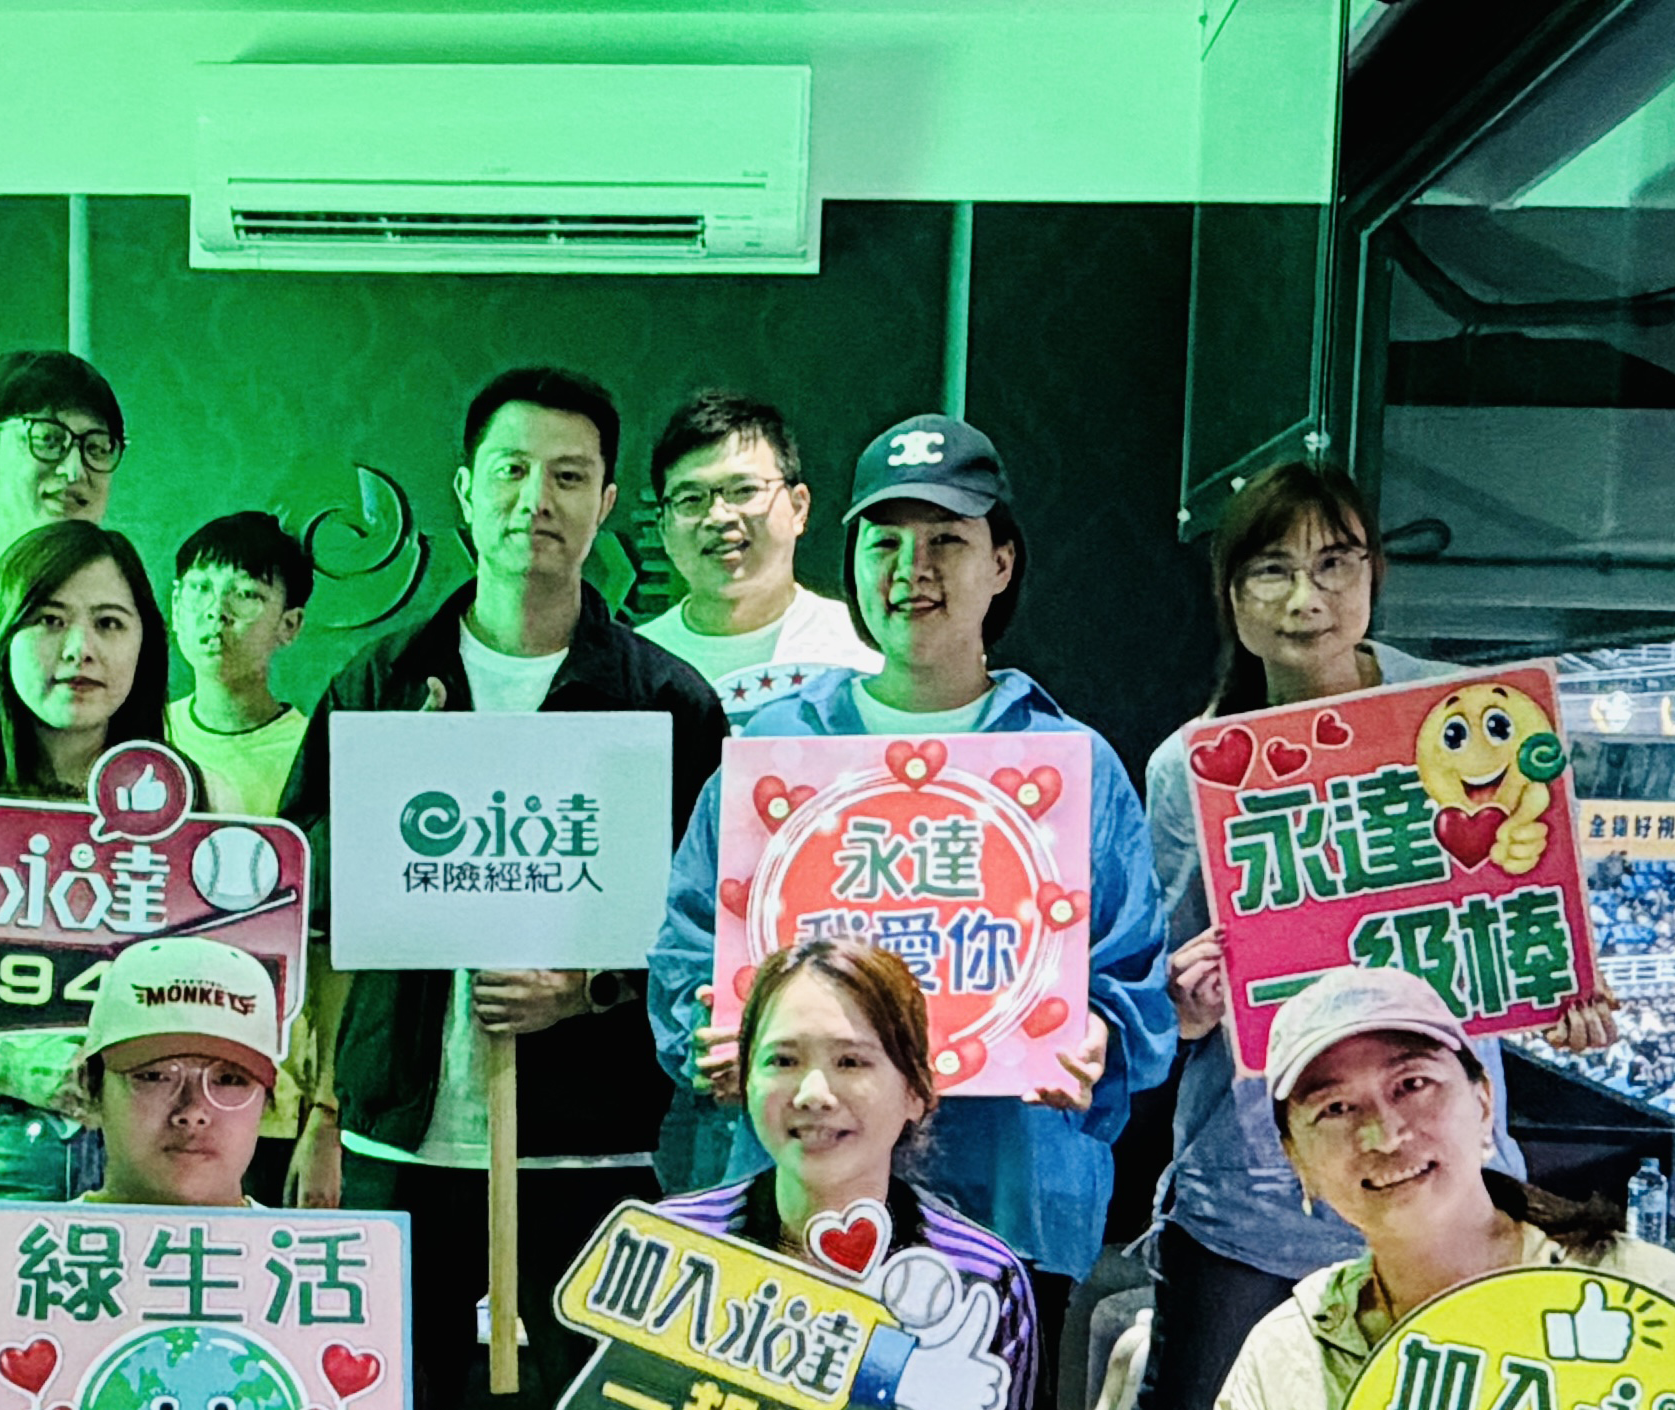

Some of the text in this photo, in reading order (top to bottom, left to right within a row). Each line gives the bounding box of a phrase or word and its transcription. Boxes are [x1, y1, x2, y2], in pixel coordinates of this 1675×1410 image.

[402, 861, 603, 893] 保險經紀人
[835, 819, 985, 902] 永達
[1228, 767, 1451, 913] 永達
[142, 984, 255, 1016] MONKEYS
[1251, 890, 1574, 1018] 一級棒
[16, 1225, 368, 1325] 綠生活
[590, 1229, 862, 1403] 加入永達
